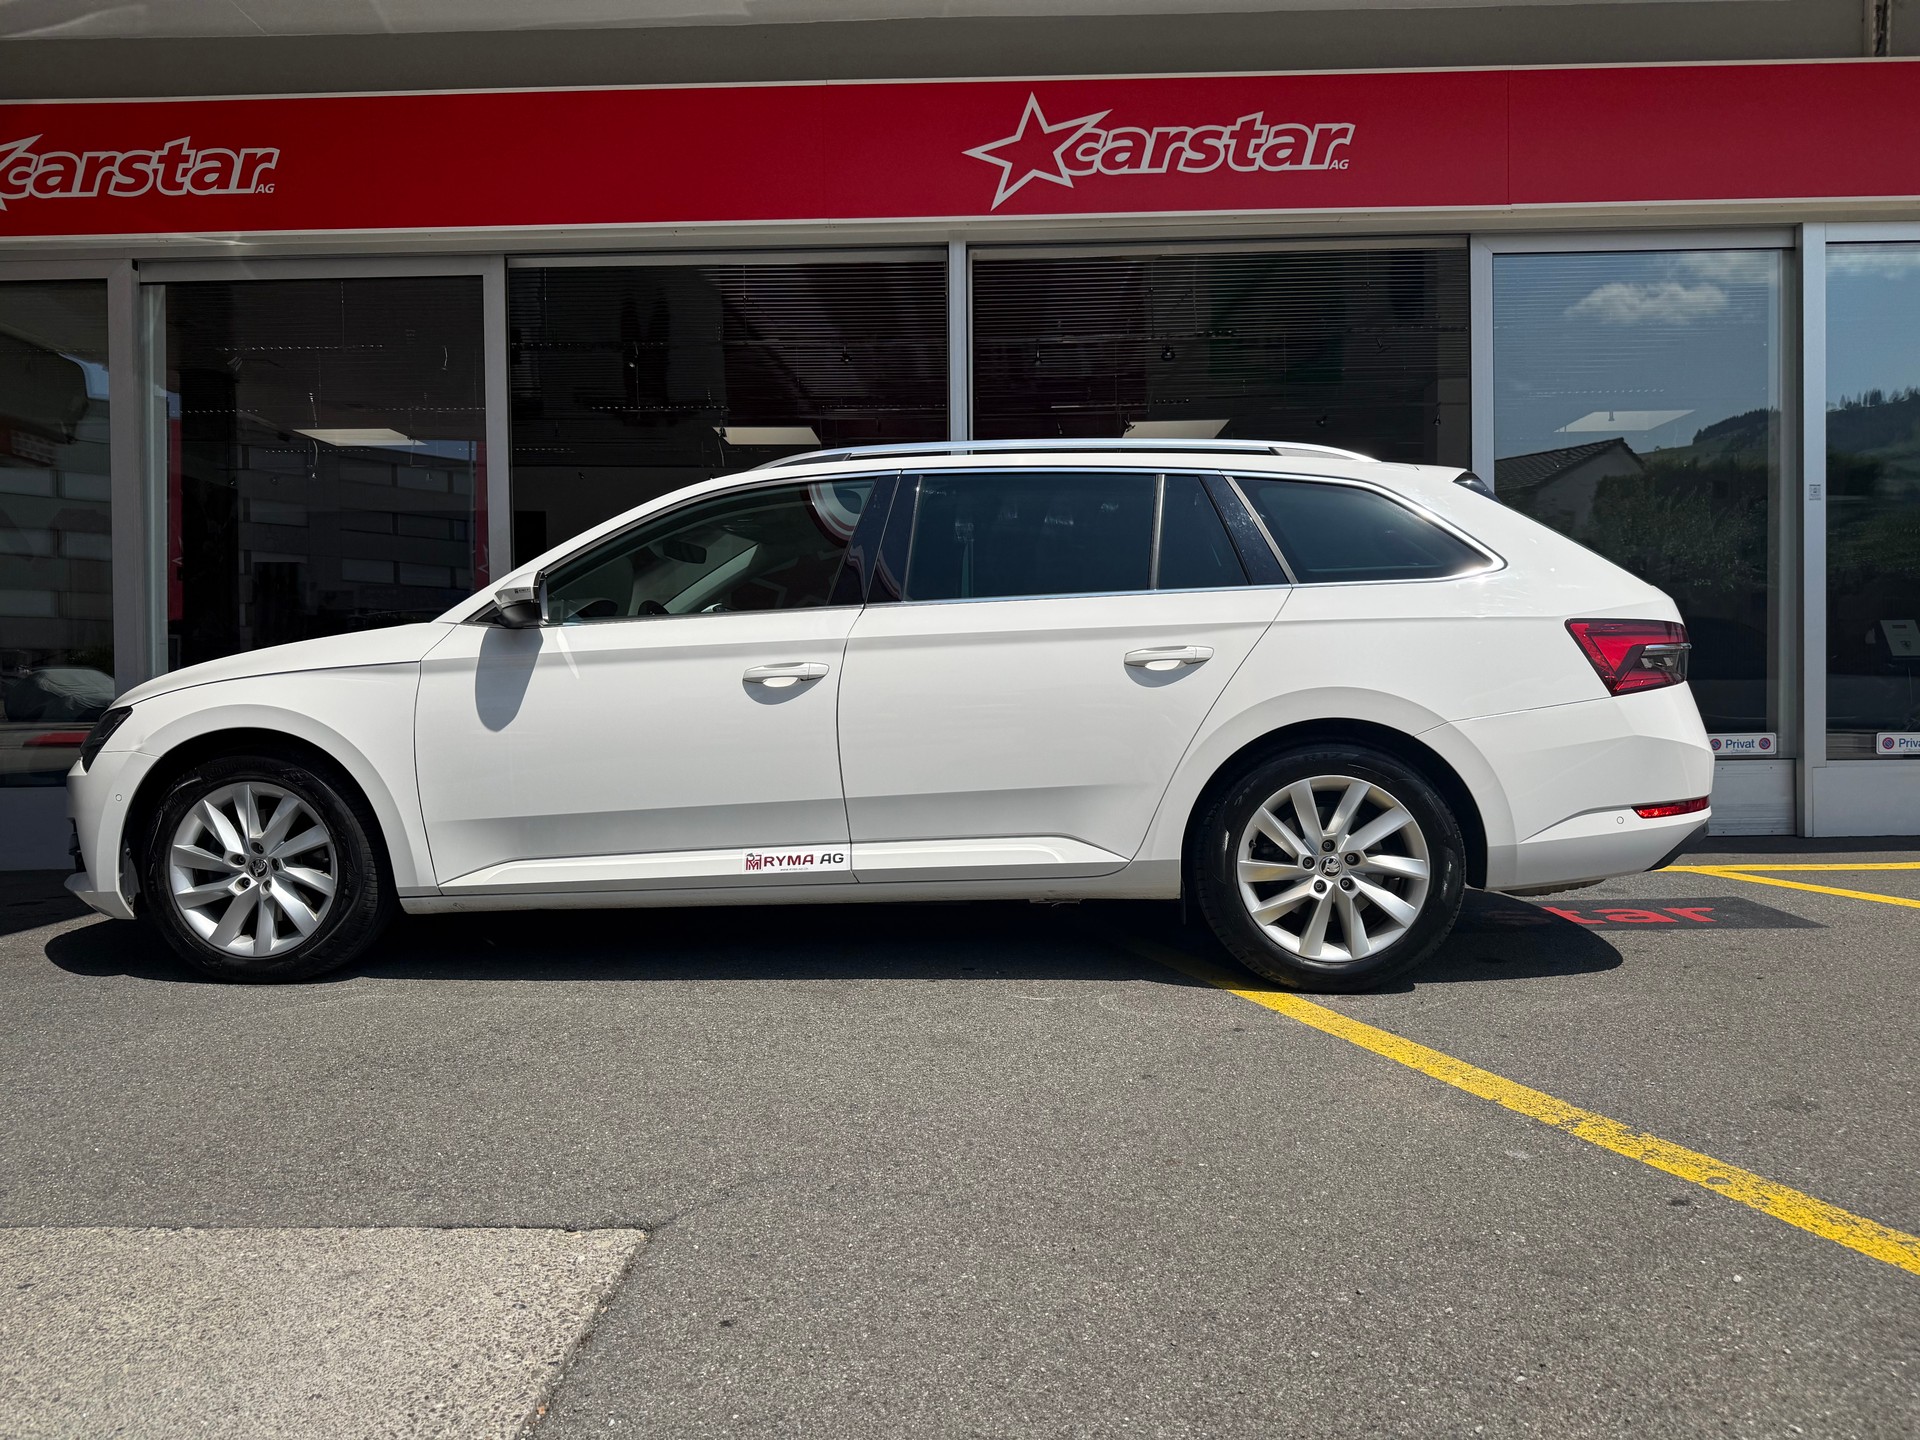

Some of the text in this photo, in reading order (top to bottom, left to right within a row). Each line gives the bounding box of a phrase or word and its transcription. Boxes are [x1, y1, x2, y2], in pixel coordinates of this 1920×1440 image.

[1053, 111, 1355, 177] carstar AG
[0, 136, 280, 199] carstar AG
[1725, 738, 1755, 749] Privat
[763, 853, 844, 867] RYMA AG
